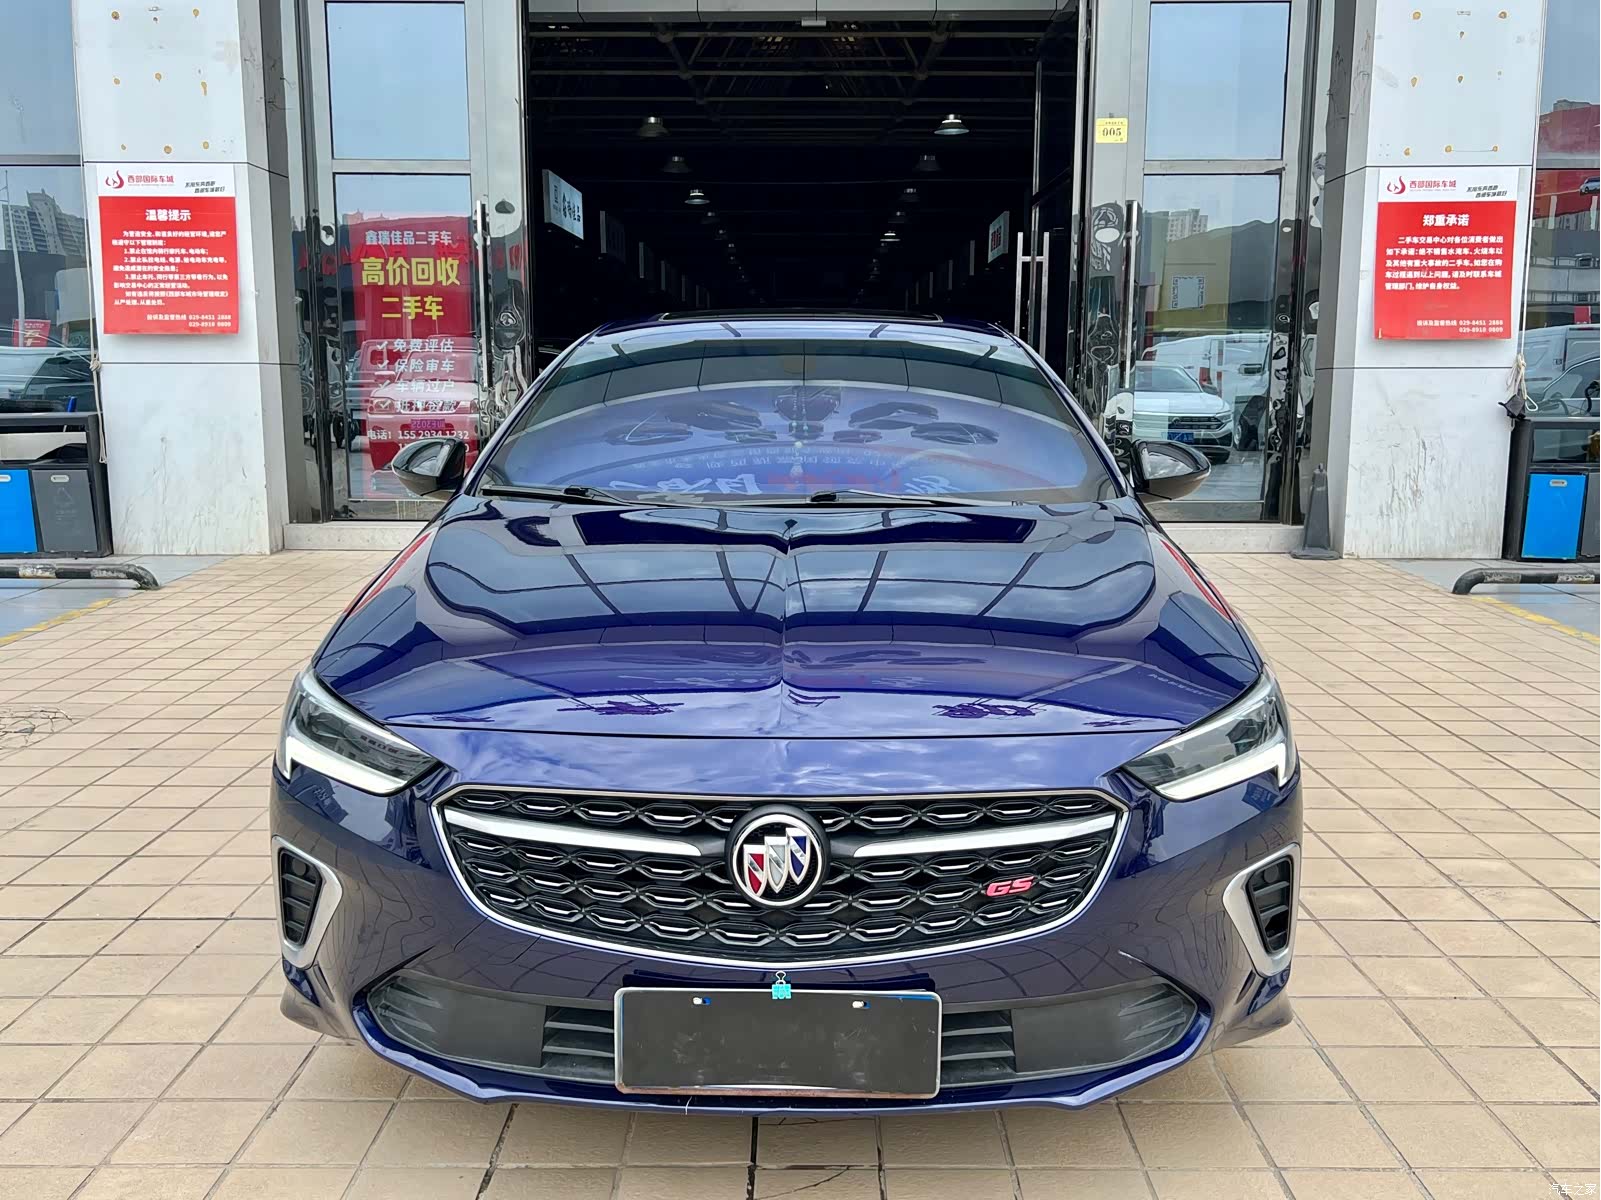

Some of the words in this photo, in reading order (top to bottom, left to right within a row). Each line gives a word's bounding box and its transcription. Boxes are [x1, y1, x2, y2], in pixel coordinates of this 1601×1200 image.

[127, 175, 175, 184] 西部国际车城
[1409, 180, 1457, 189] 西部国际车城
[145, 209, 192, 222] 温馨提示
[1422, 213, 1470, 227] 郑重承诺
[365, 230, 452, 246] 鑫瑞佳品二手车
[360, 256, 461, 287] 高价回收
[381, 295, 445, 321] 二手车
[392, 339, 455, 353] 免费评估
[394, 358, 455, 373] 保险审车
[395, 379, 455, 393] 车辆过户
[397, 430, 416, 440] 155
[445, 430, 470, 439] 1232
[985, 876, 1034, 897] GS
